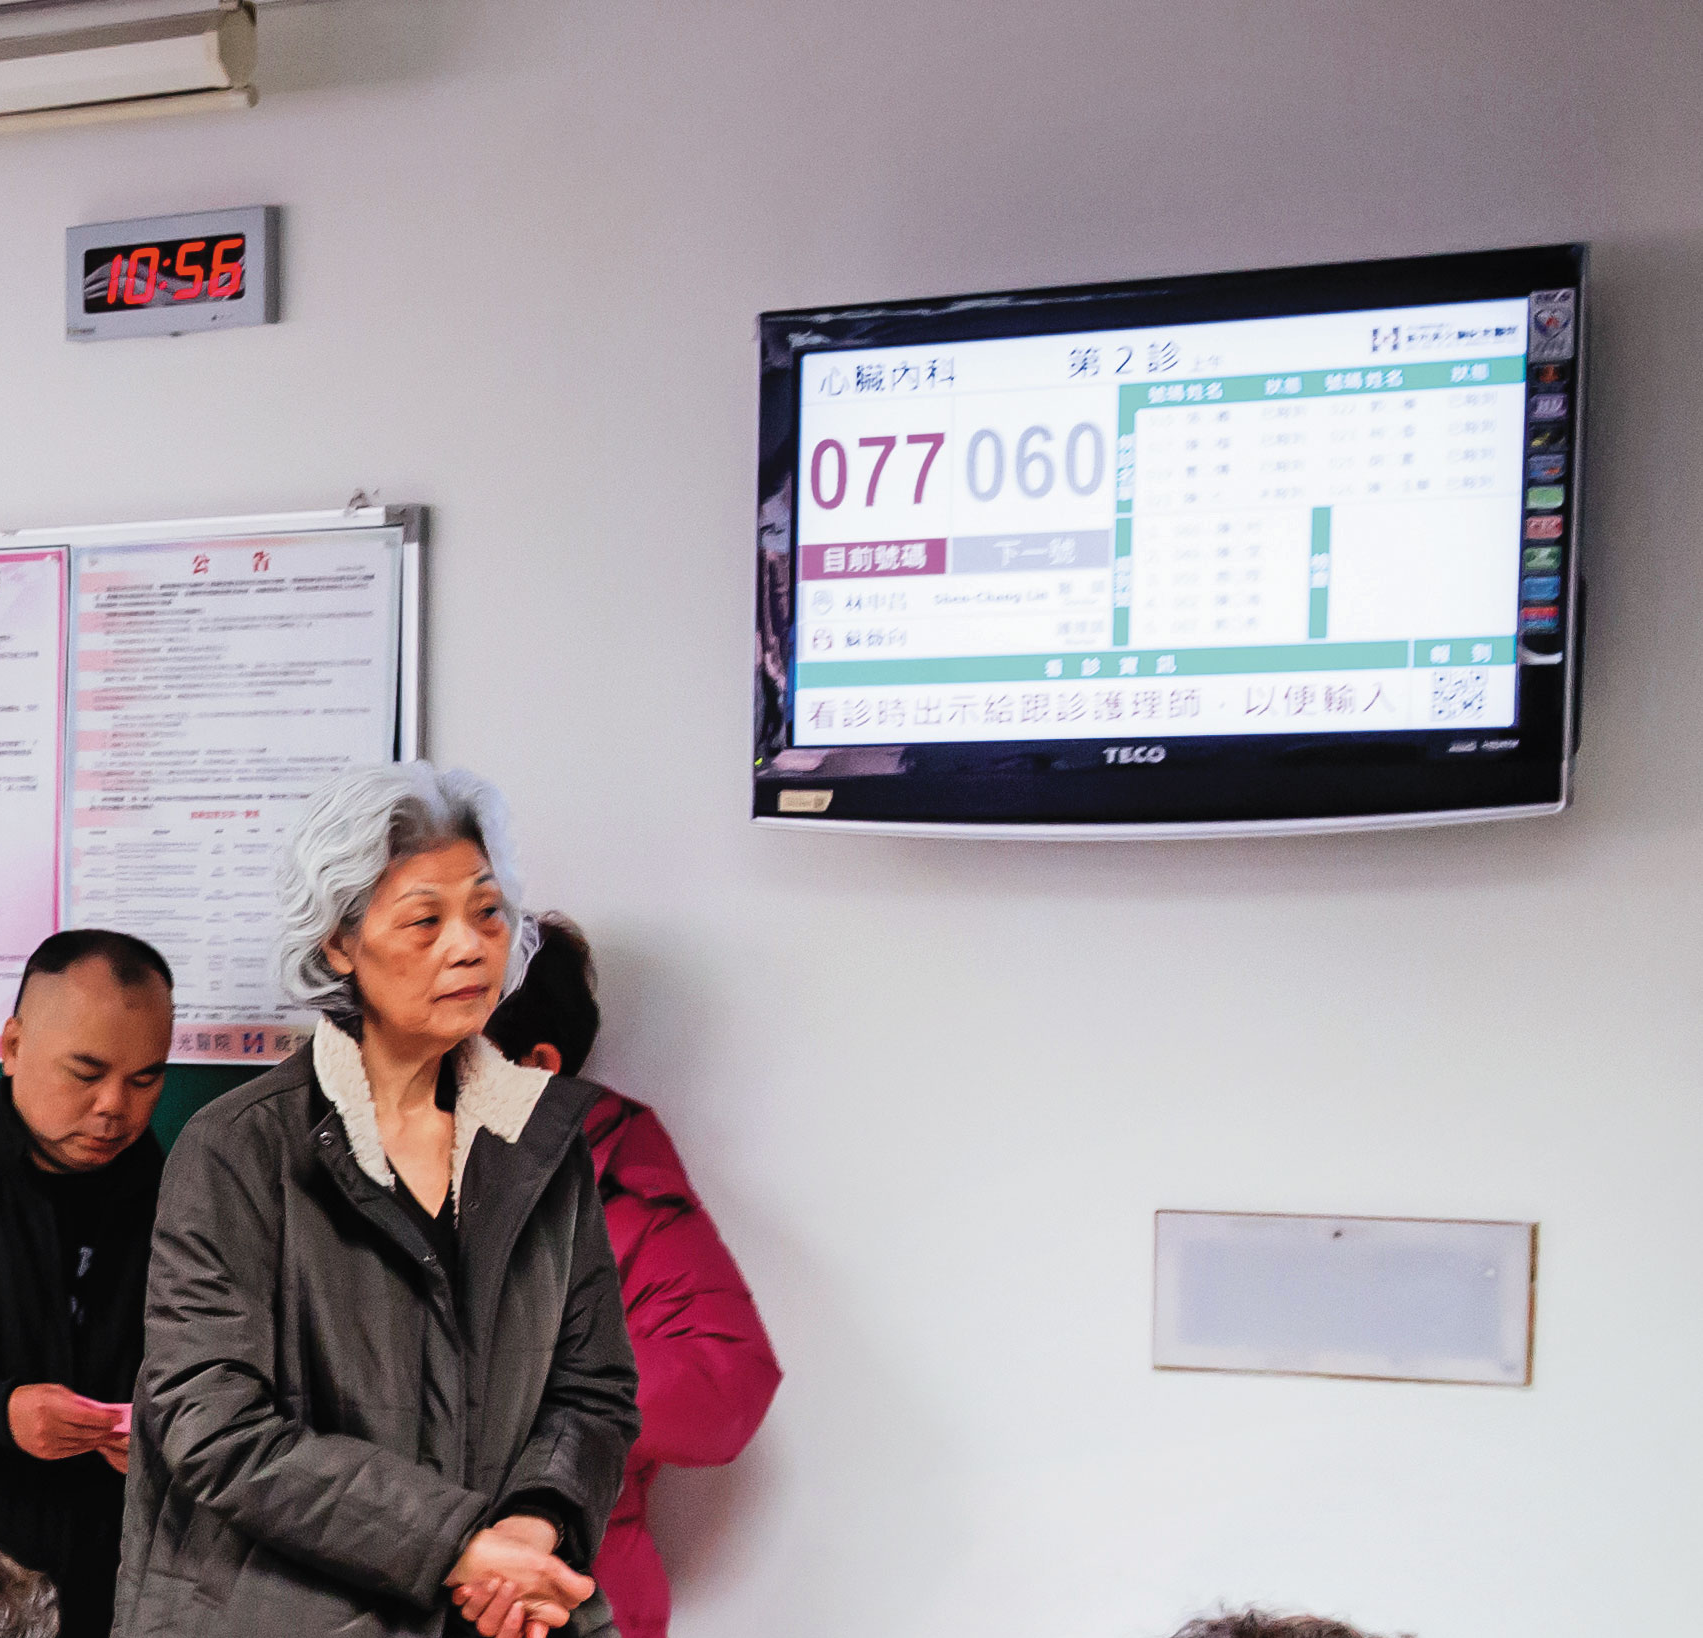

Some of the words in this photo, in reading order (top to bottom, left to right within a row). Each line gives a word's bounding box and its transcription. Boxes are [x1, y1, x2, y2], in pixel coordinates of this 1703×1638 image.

[107, 238, 244, 305] 10:56
[819, 356, 957, 396] 心臟內科
[1067, 341, 1182, 379] 第2診
[810, 431, 947, 511] 077
[965, 421, 1107, 502] 060
[823, 542, 928, 573] 目前號碼
[993, 537, 1077, 567] 下一號
[1102, 744, 1167, 765] TECO
